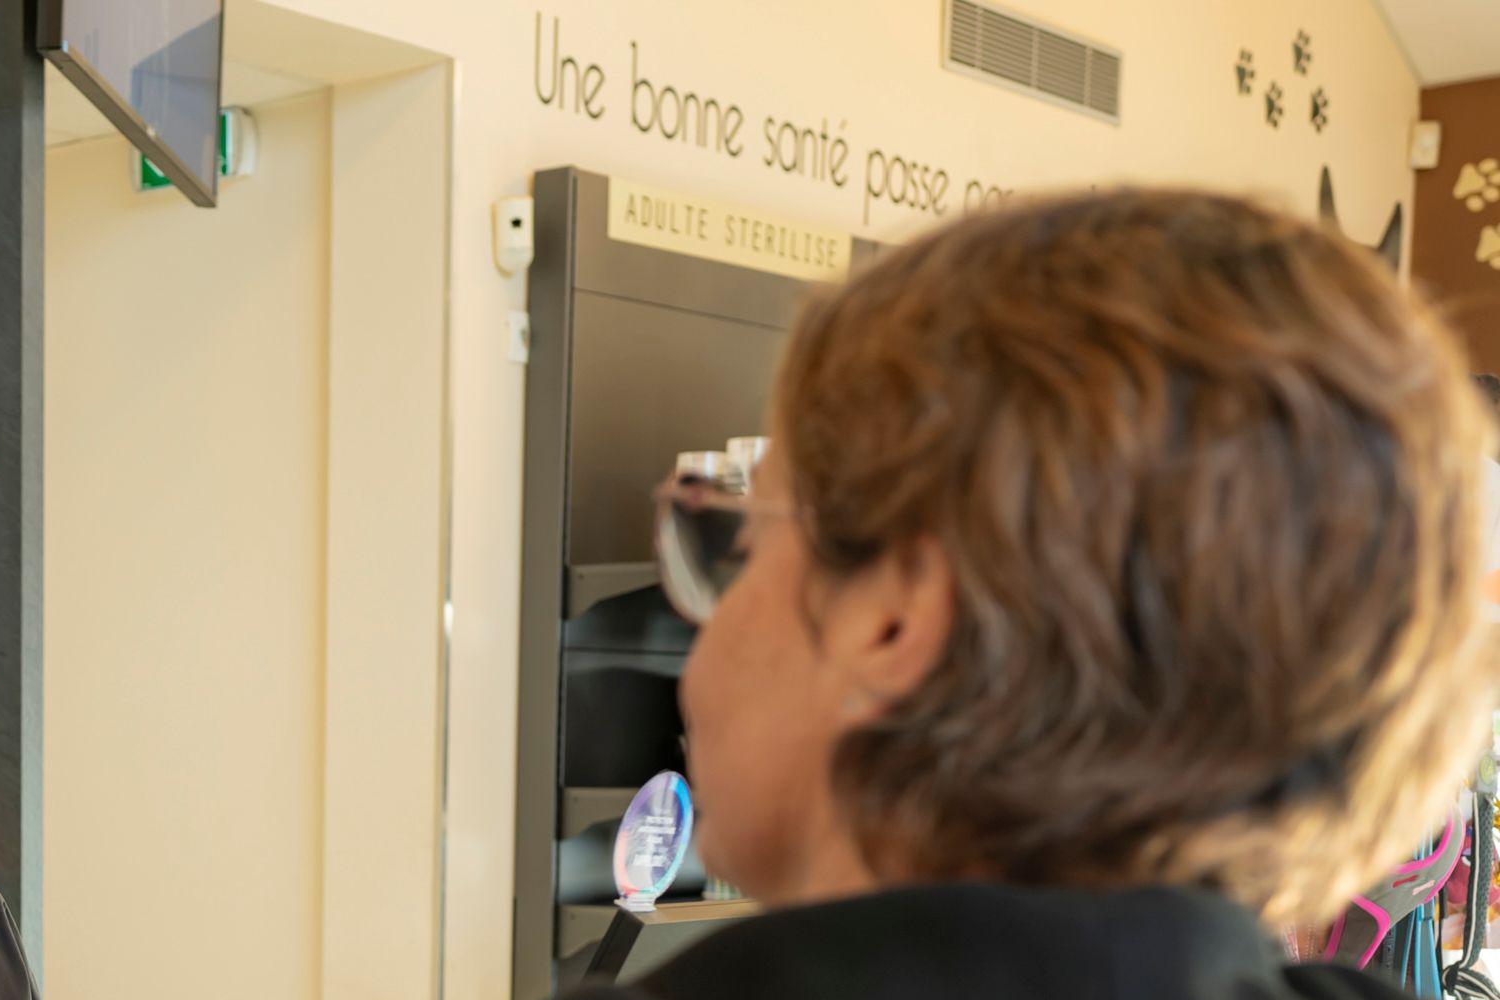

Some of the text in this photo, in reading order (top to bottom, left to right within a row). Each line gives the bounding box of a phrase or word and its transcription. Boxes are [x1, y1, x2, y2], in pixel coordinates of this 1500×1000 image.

[533, 9, 606, 120] Une
[628, 40, 745, 158] bonne
[762, 117, 850, 188] santé
[863, 149, 950, 227] passe
[623, 192, 840, 269] ADULTE STERILISE
